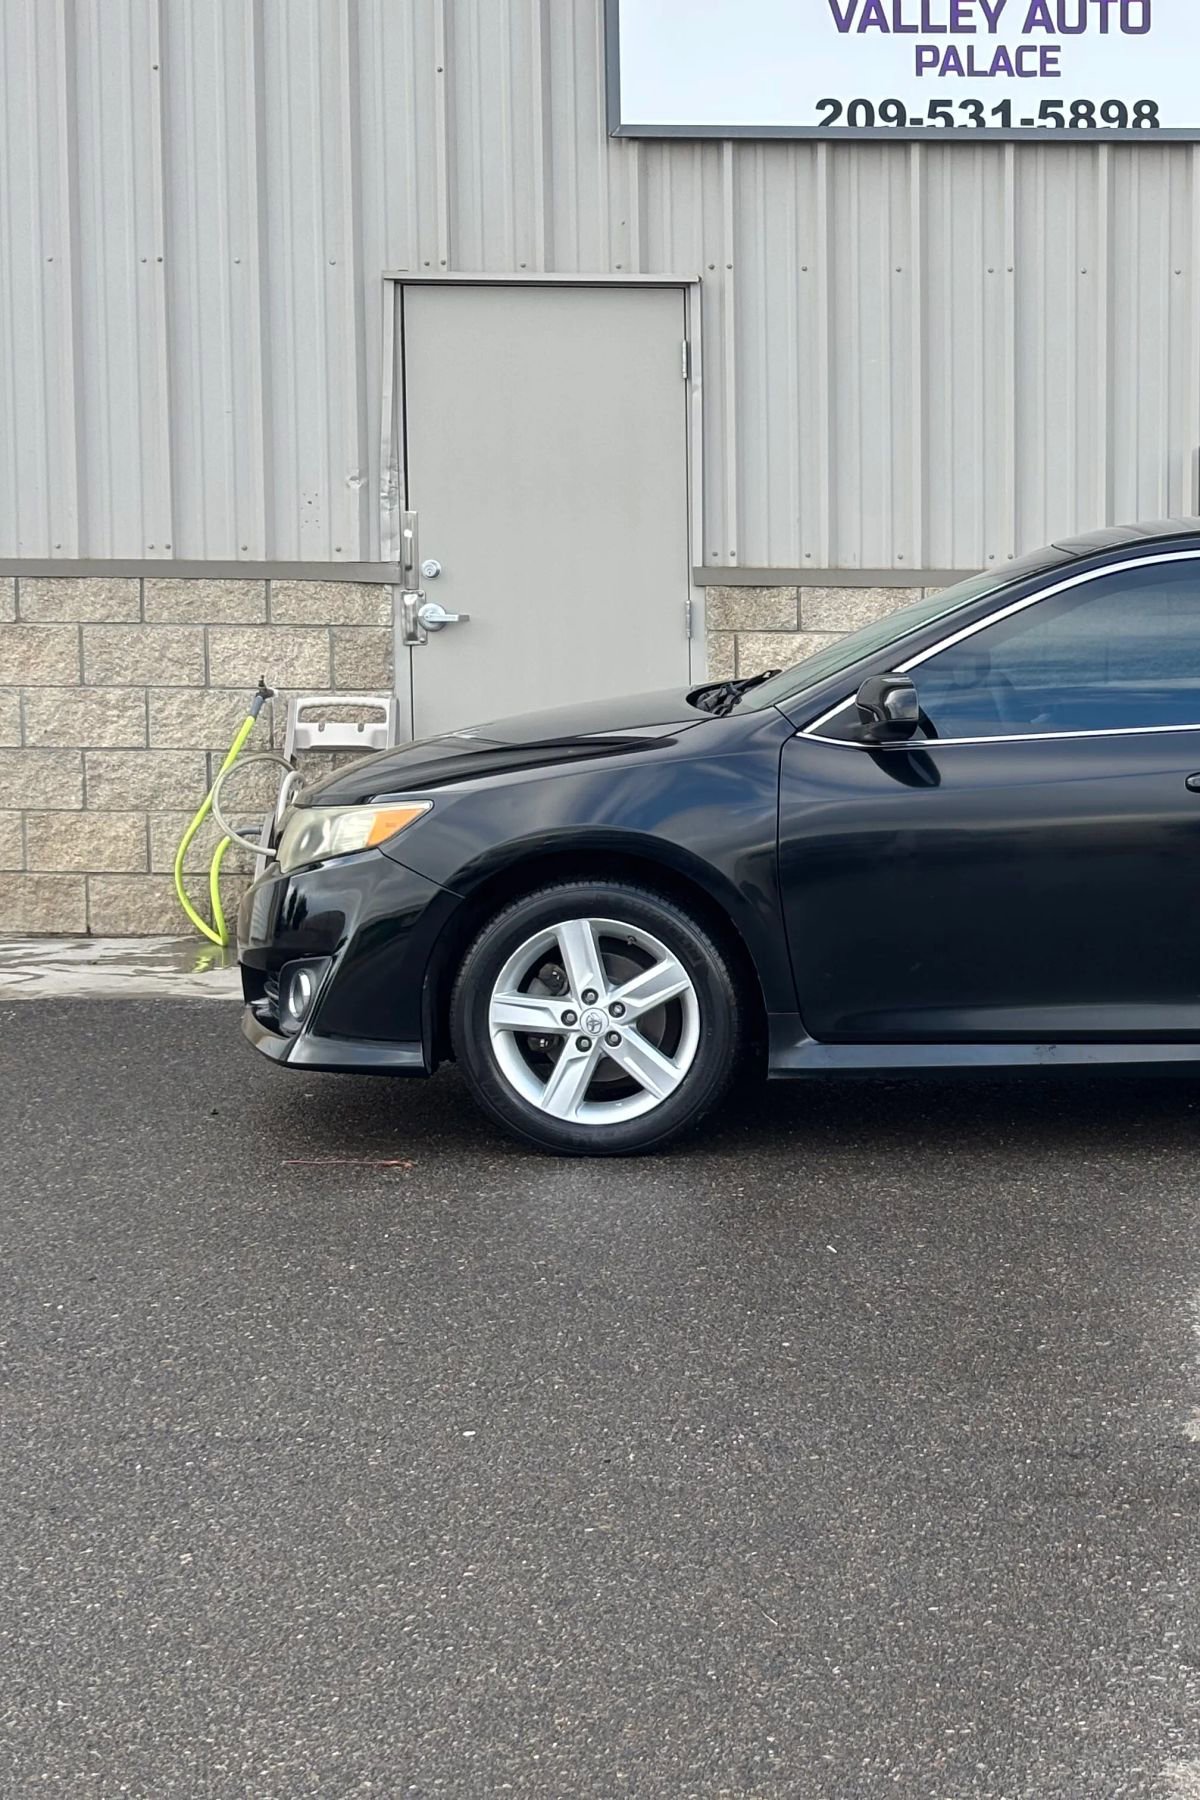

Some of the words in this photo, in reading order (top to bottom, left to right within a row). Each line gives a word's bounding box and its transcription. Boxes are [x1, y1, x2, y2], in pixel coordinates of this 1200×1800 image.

[828, 0, 1007, 33] VALLEY
[1022, 0, 1151, 34] AUTO
[915, 45, 1061, 78] PALACE
[815, 98, 1160, 128] 209-531-5898
